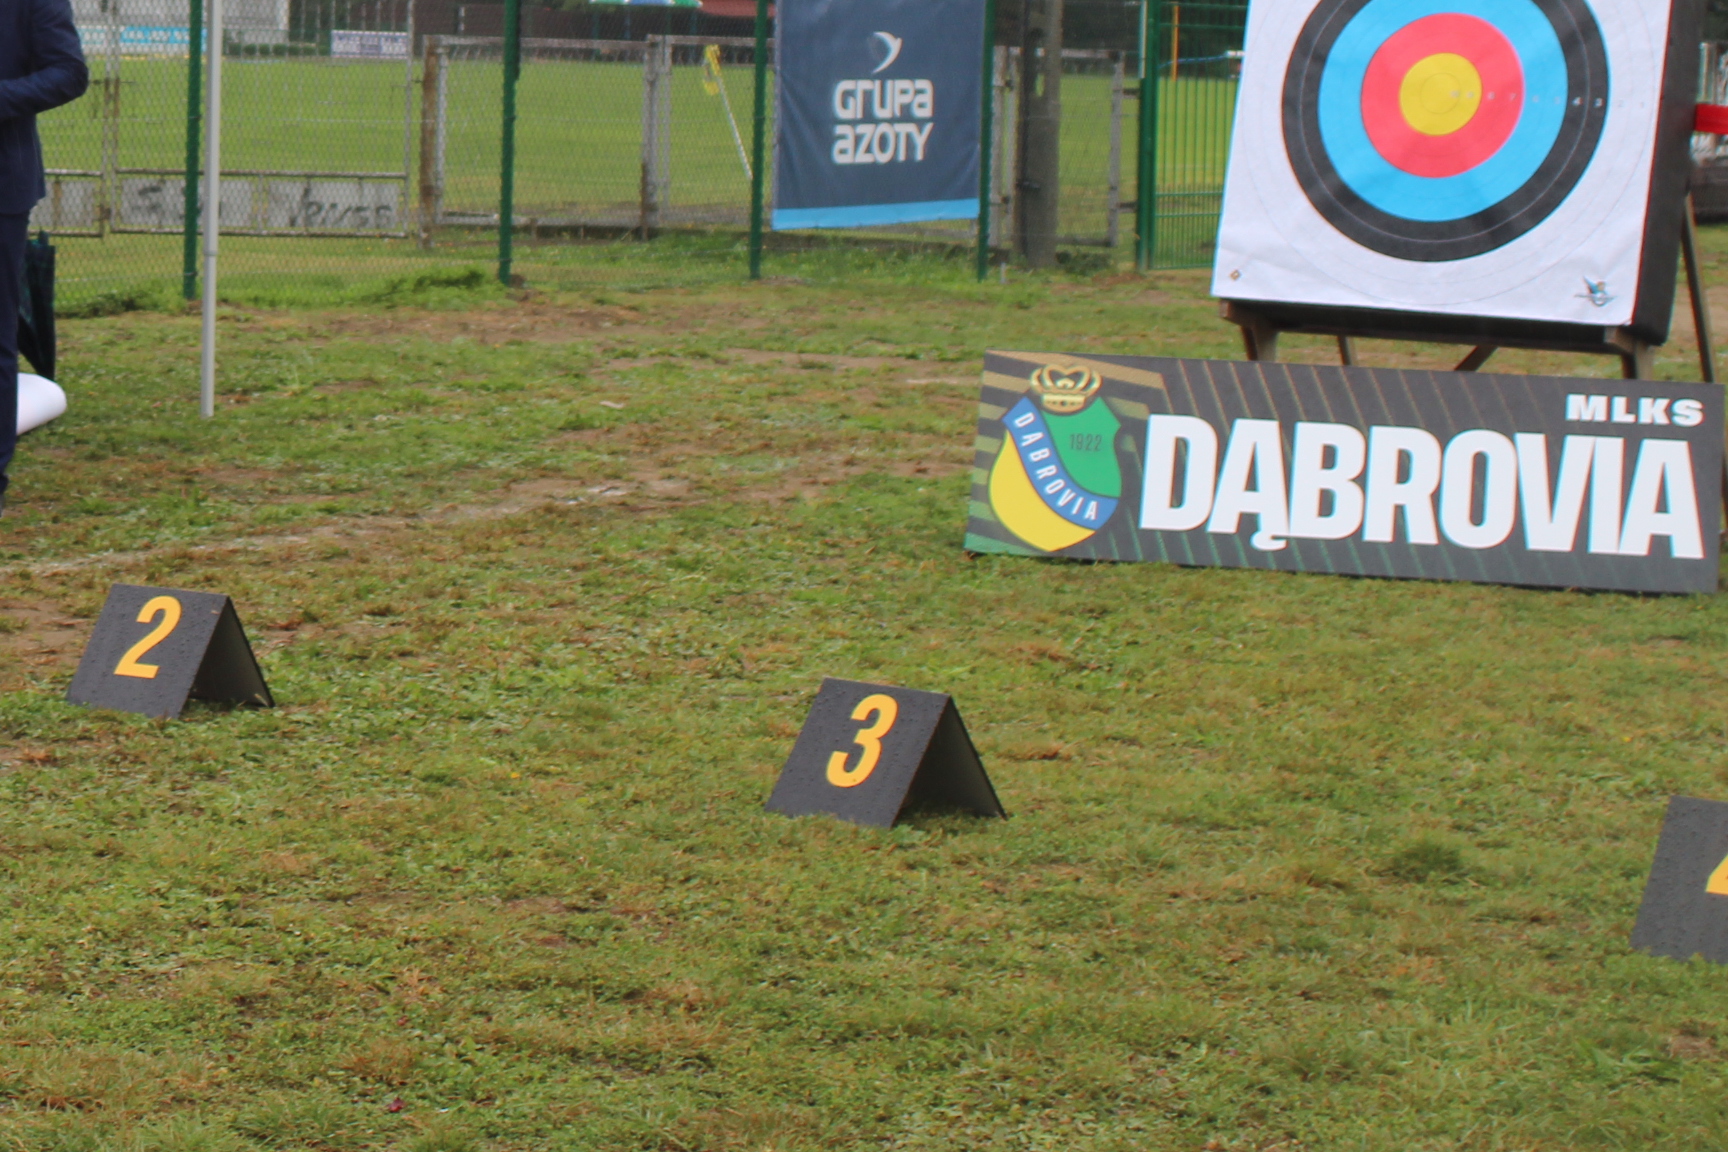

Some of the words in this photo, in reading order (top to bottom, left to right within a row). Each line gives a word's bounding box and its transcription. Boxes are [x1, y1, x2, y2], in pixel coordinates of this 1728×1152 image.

[1070, 433, 1103, 452] 1922
[1565, 393, 1704, 427] MLKS
[1013, 411, 1099, 521] DABROVIA
[1139, 413, 1704, 559] DĄBROVIA
[113, 595, 182, 680] 2
[826, 693, 899, 788] 3
